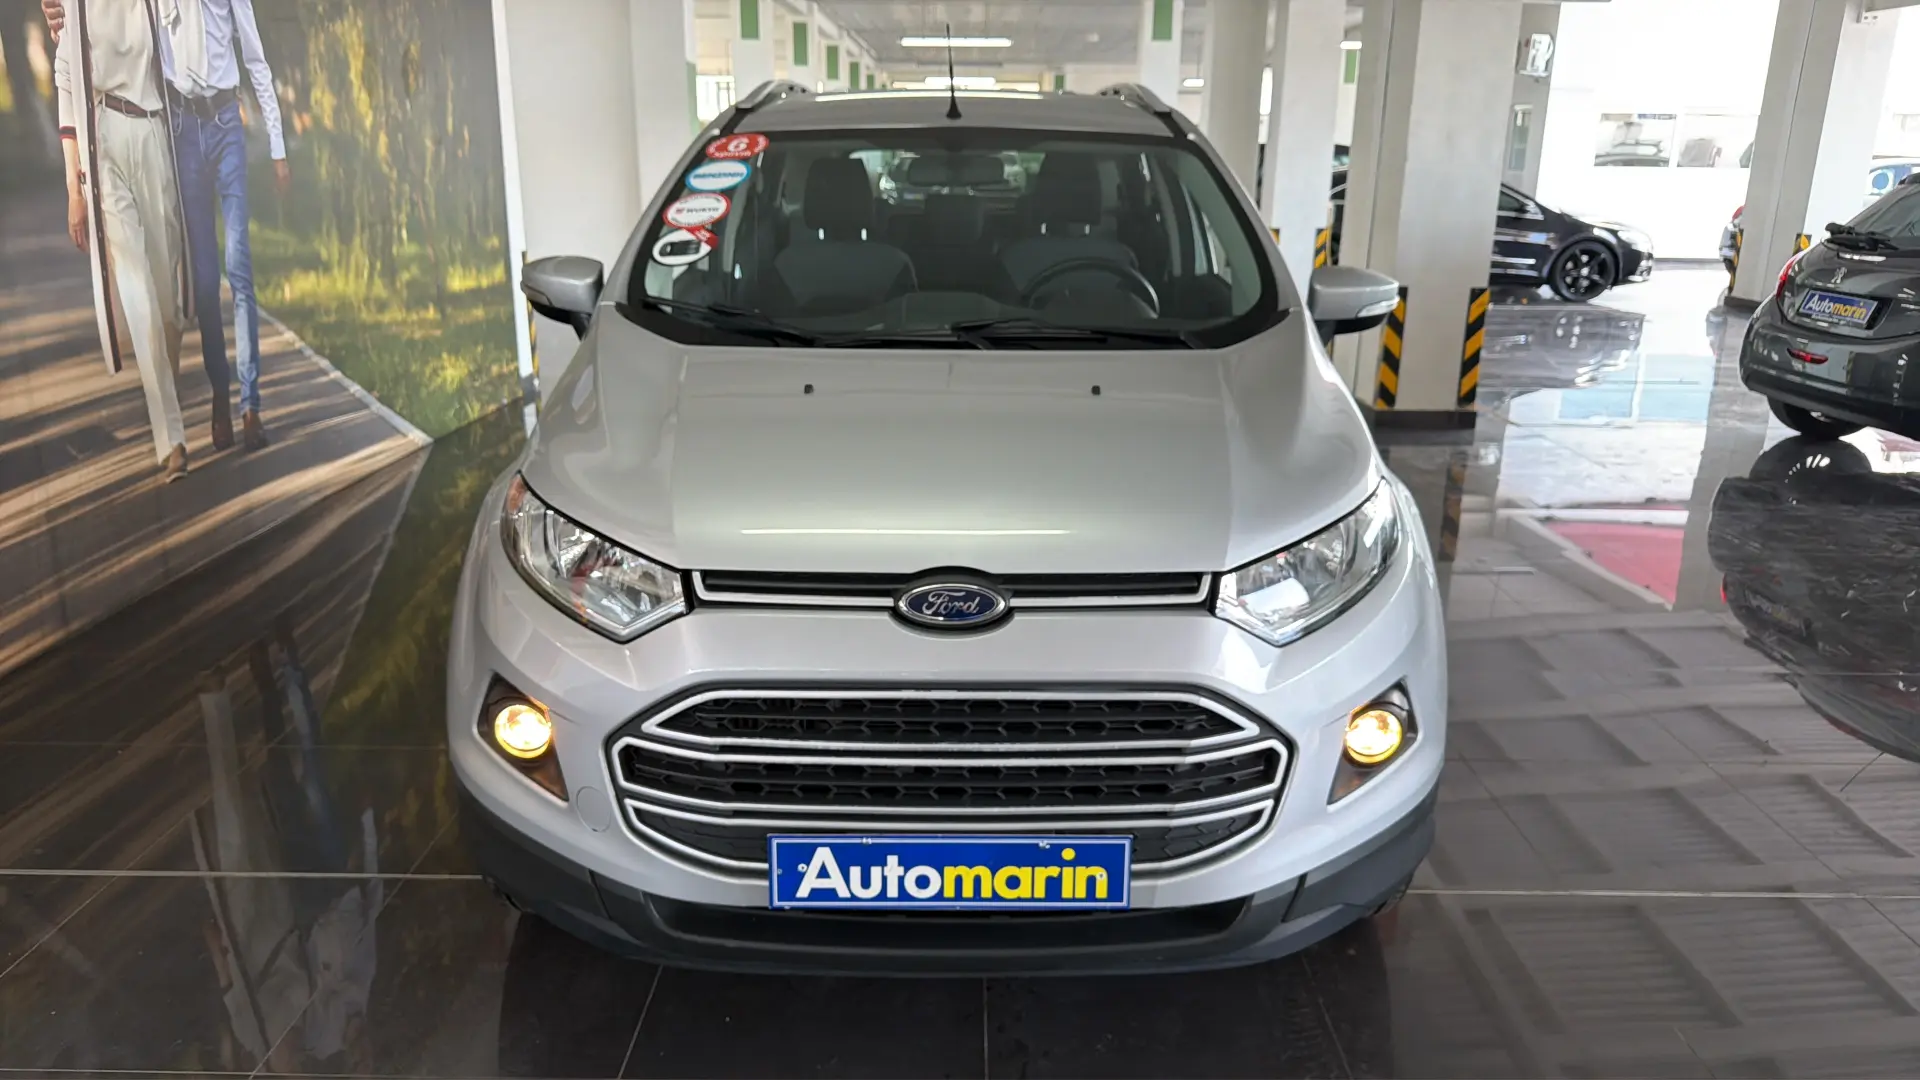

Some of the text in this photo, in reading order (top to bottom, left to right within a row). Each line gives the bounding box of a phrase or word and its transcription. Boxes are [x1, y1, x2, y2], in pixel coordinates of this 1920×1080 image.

[727, 137, 750, 152] 6
[1805, 294, 1867, 320] Automarin
[922, 590, 981, 615] Ford
[795, 846, 1109, 899] Automarin
